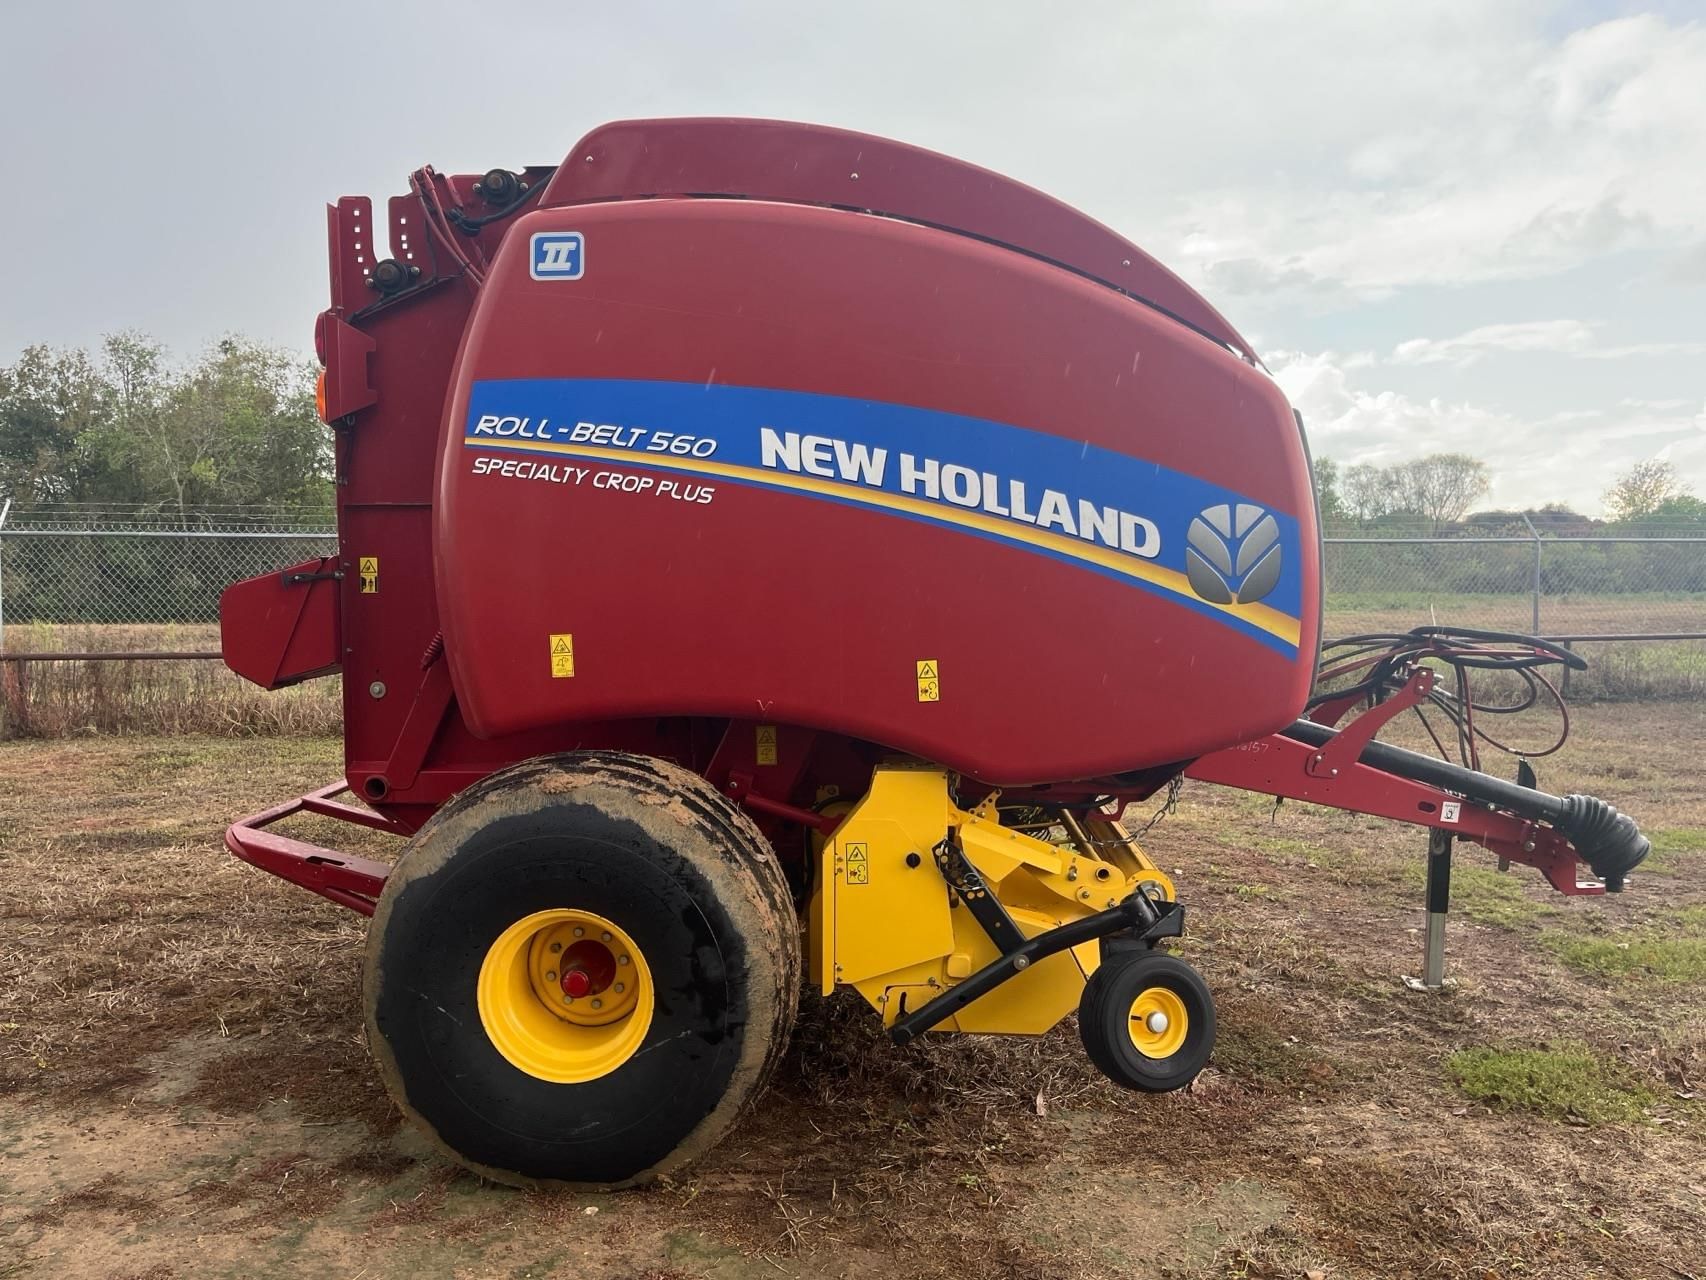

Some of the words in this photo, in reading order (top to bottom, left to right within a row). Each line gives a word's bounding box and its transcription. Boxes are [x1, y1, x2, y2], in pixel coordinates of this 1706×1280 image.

[537, 241, 577, 271] II
[647, 431, 717, 457] 560
[472, 457, 589, 485] SPECIALTY
[593, 471, 654, 494] CROP
[655, 480, 716, 504] PLUS
[760, 427, 888, 487] NEW
[899, 453, 1161, 558] HOLLAND
